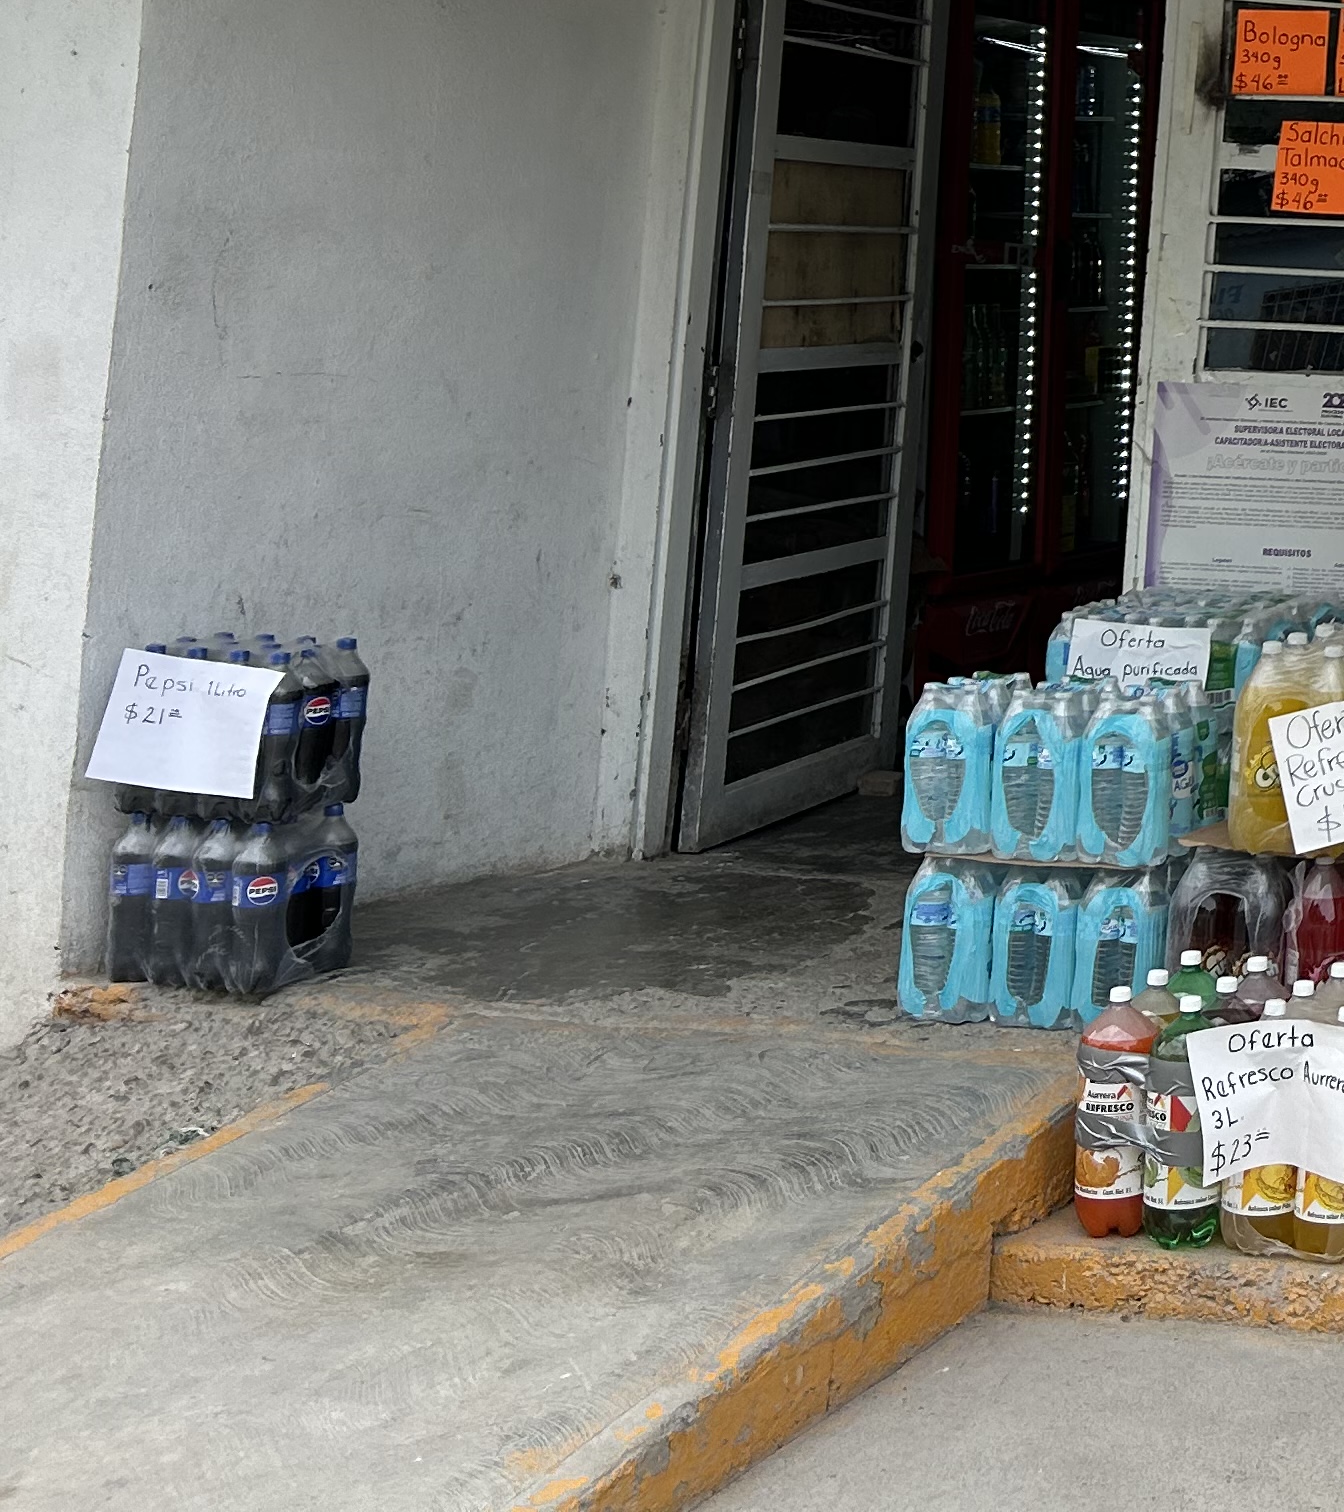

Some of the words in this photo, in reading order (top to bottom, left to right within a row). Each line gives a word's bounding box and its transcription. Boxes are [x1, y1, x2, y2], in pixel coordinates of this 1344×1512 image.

[1243, 19, 1326, 52] Bologna
[1264, 397, 1289, 409] IEC
[1285, 426, 1326, 437] ELECTORAL
[1286, 459, 1298, 475] y
[1262, 547, 1312, 558] REQUISITOS
[1100, 628, 1165, 649] Oferta
[1072, 655, 1112, 678] Agua
[1121, 660, 1198, 682] purificada
[132, 662, 195, 698] Pepsi
[247, 884, 278, 897] PEPSI
[1227, 1025, 1315, 1054] Oferta
[1201, 1065, 1294, 1102] Refresco
[1086, 1089, 1117, 1100] Aurrera
[1085, 1102, 1135, 1113] REFRESCO
